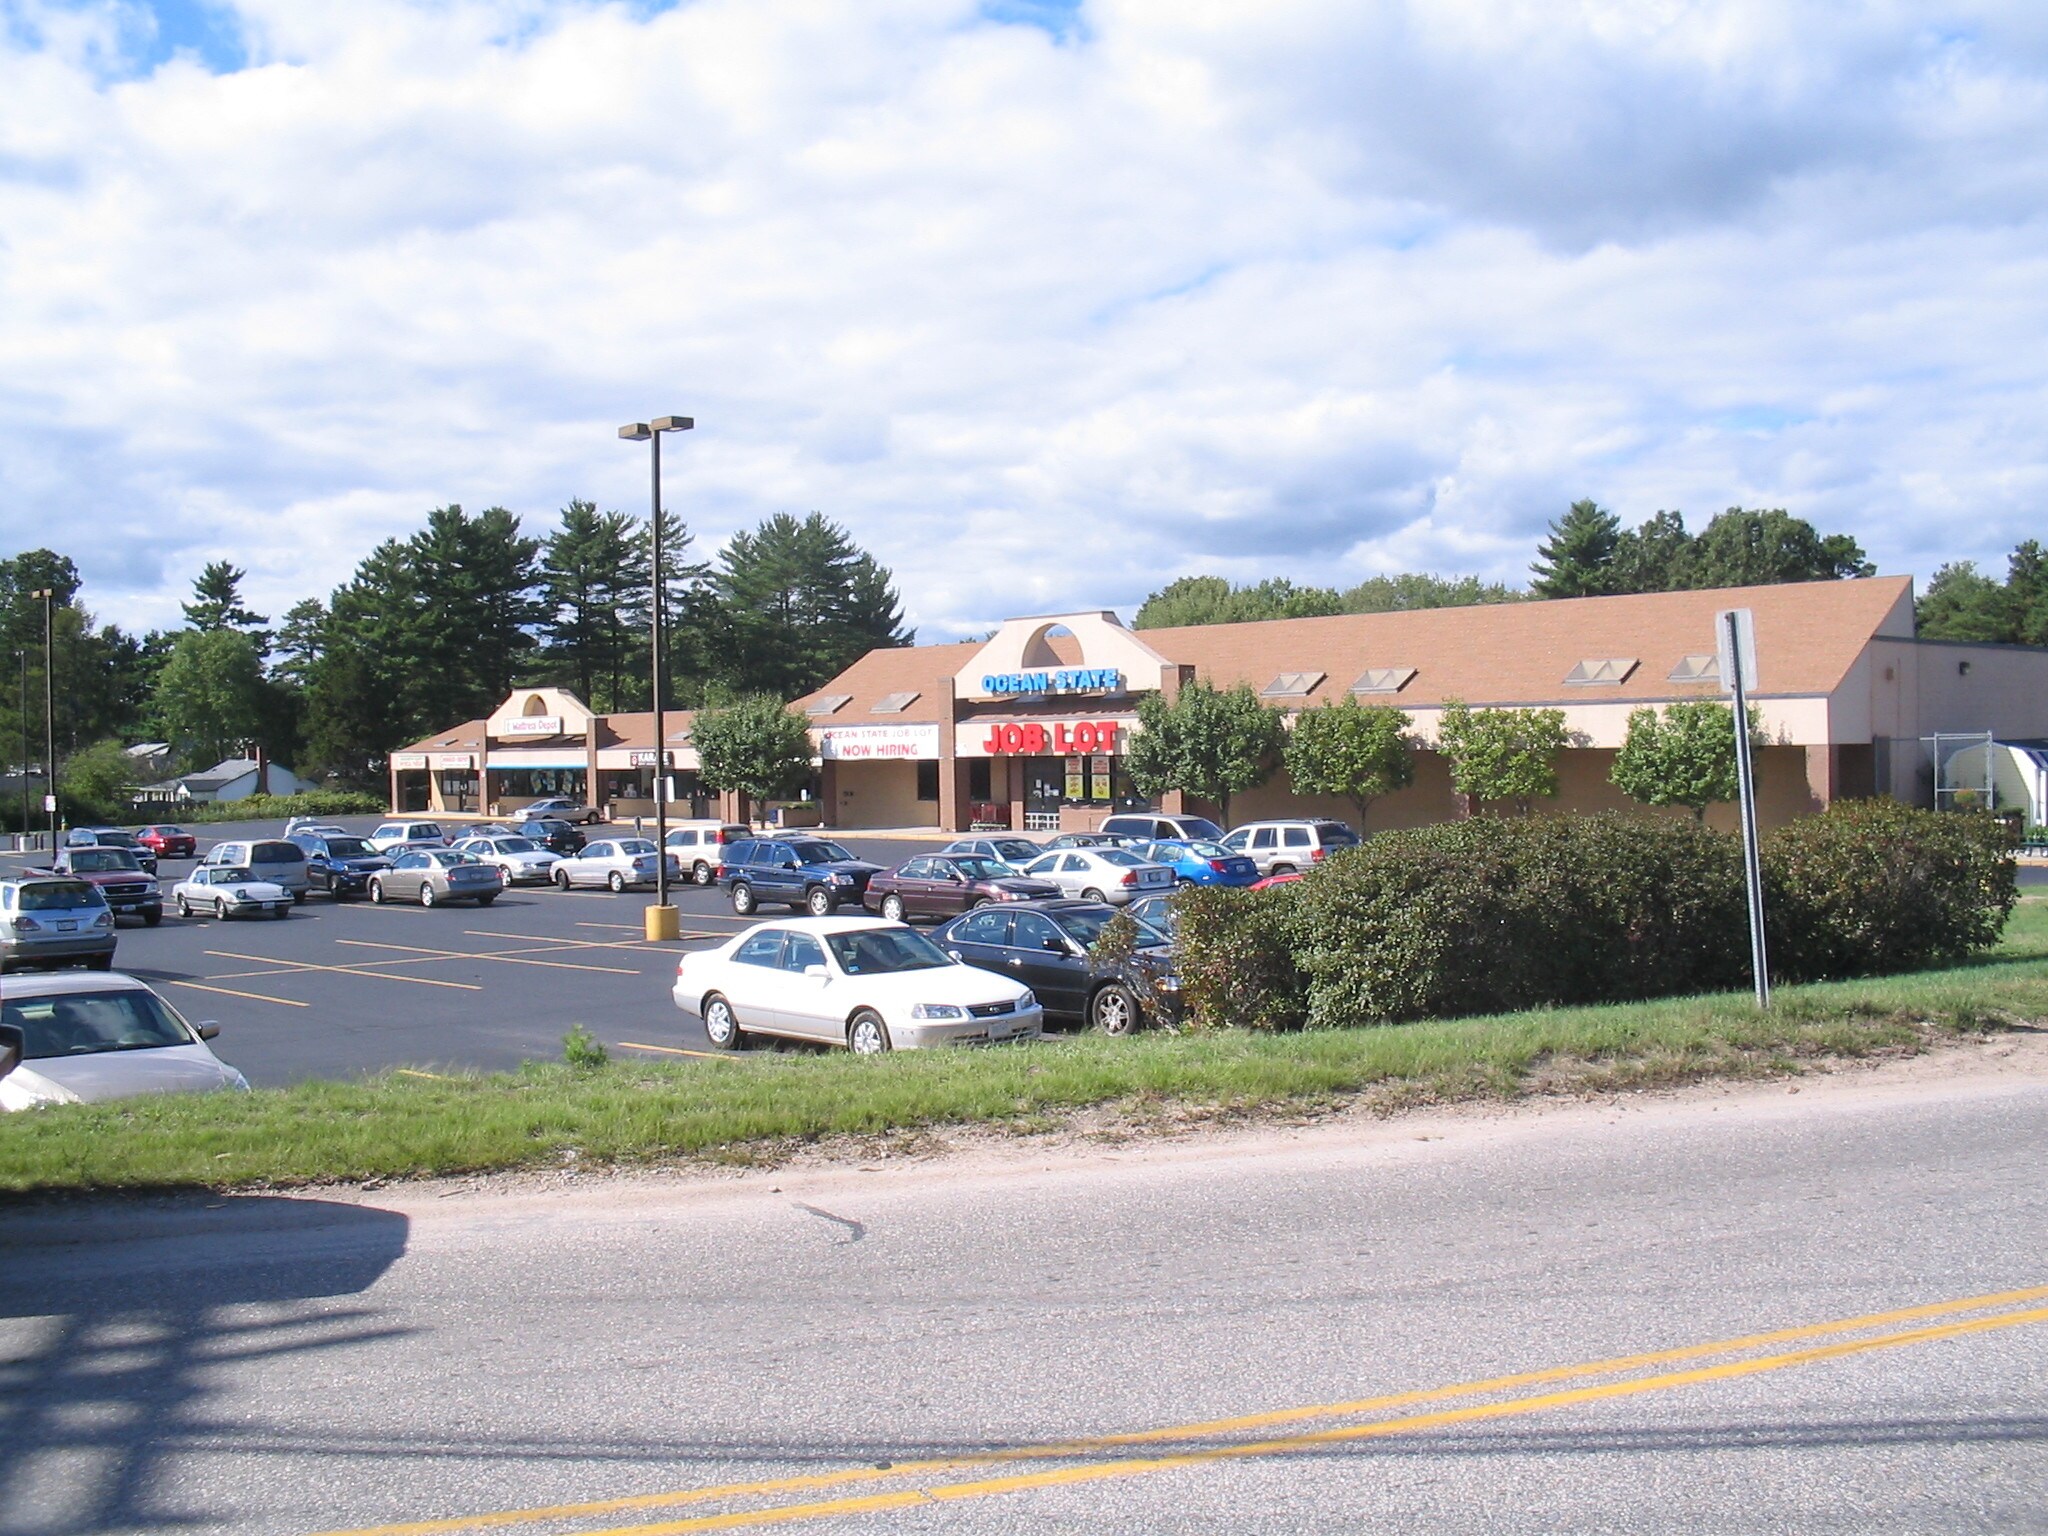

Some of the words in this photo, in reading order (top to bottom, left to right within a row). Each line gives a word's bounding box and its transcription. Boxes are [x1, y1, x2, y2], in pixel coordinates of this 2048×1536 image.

[982, 672, 1048, 693] OCEAN
[1054, 668, 1118, 690] STATE
[825, 729, 858, 740] OCEAN
[862, 728, 889, 739] STATE
[892, 728, 911, 738] JOB
[914, 728, 932, 737] LOT
[983, 722, 1046, 753] JOB
[1054, 721, 1119, 752] LOT
[638, 751, 669, 762] KARE
[842, 744, 872, 757] NOW
[876, 743, 919, 756] HIRING
